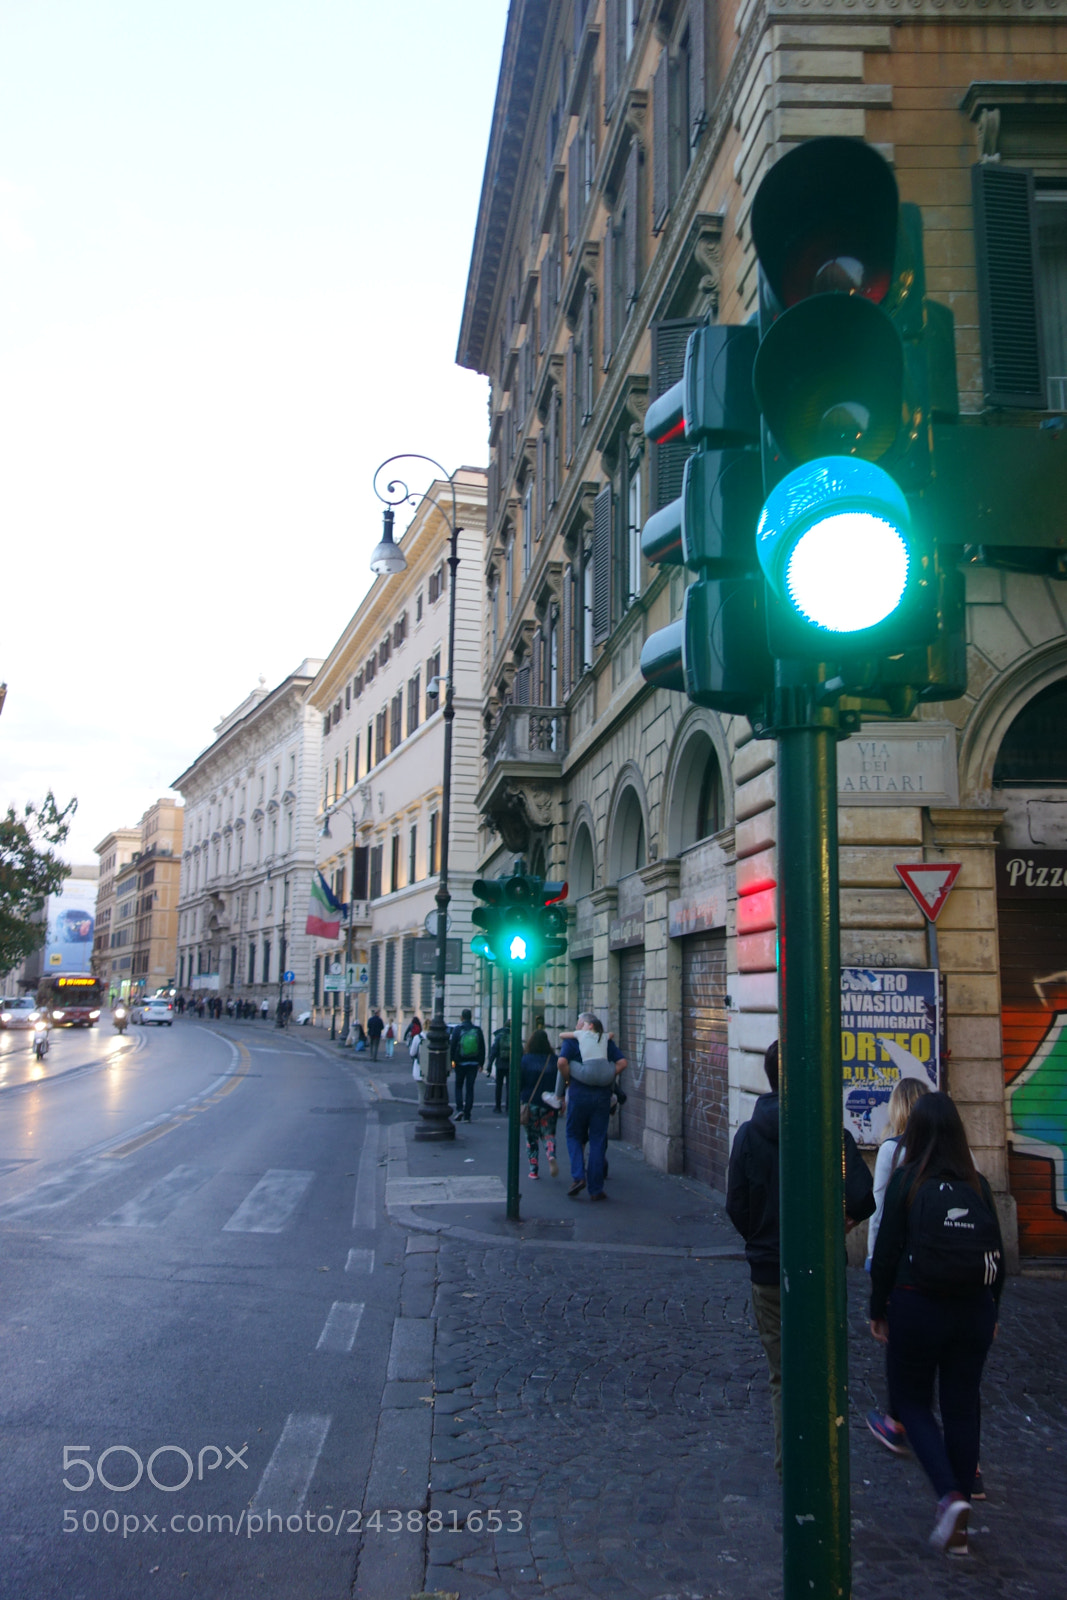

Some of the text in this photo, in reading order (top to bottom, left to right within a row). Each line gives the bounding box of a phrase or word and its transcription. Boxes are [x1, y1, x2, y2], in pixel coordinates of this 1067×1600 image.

[857, 742, 890, 758] VIA
[862, 760, 887, 772] DEI
[837, 775, 924, 791] ARTARI
[1005, 858, 1067, 887] Pizz
[840, 994, 925, 1013] NVASIONE
[857, 1015, 926, 1029] IMMIGRATI
[841, 1031, 931, 1063] ORTEO
[854, 1067, 866, 1080] IL
